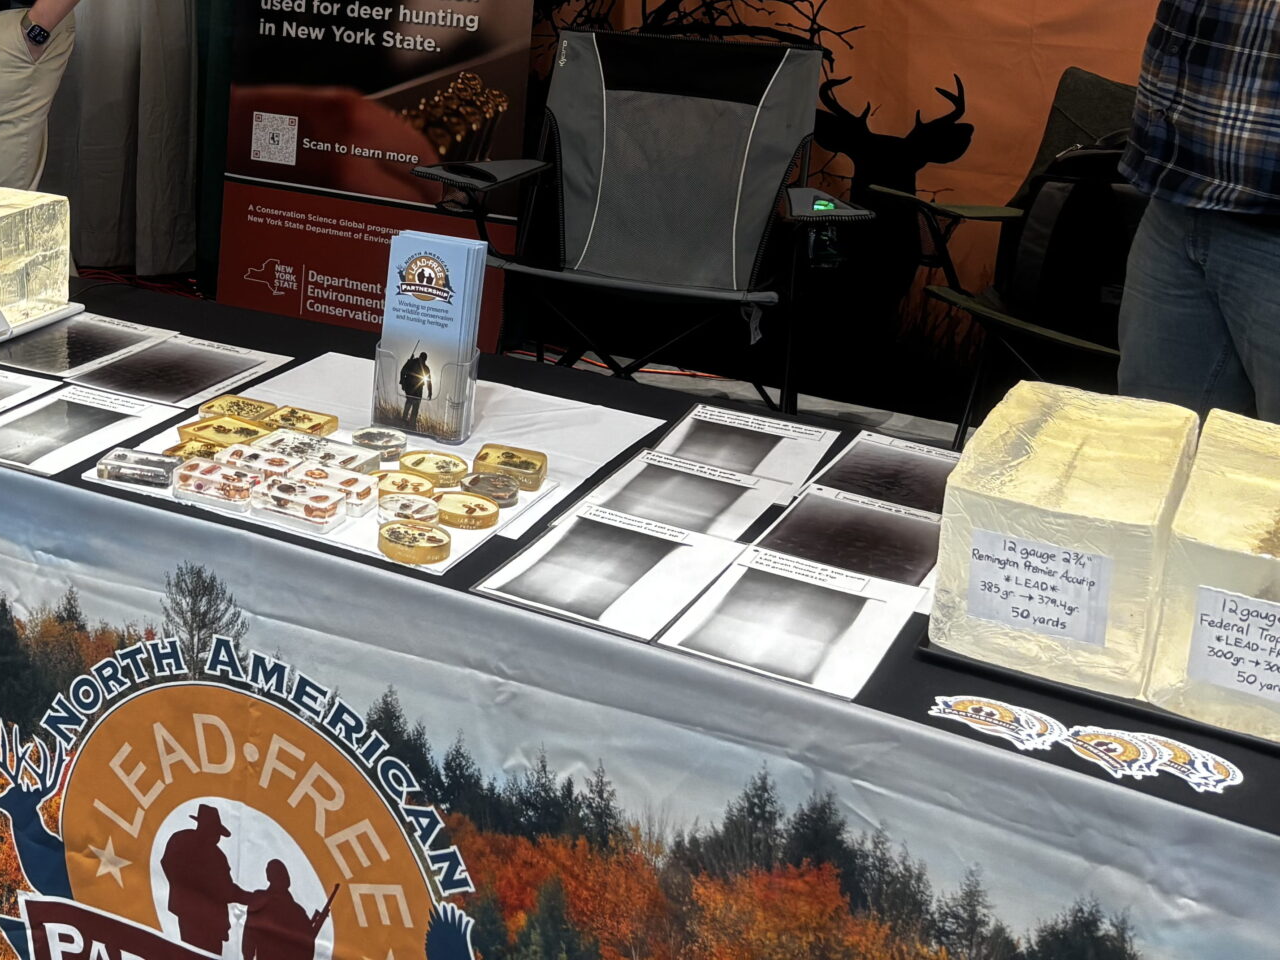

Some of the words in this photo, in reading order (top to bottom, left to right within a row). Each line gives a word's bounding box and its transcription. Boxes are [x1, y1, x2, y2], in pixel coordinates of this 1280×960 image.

[347, 1, 392, 20] deer
[399, 5, 479, 31] hunting
[259, 19, 275, 35] in
[283, 21, 325, 40] New
[332, 26, 375, 46] York
[382, 30, 440, 52] State.
[303, 138, 331, 151] Scan
[335, 142, 347, 154] to
[351, 145, 382, 160] learn
[386, 151, 418, 163] more
[247, 214, 263, 223] New
[266, 218, 283, 227] York
[284, 220, 304, 230] State
[306, 224, 352, 239] Department
[354, 230, 362, 239] of
[256, 205, 305, 220] Conservation
[307, 214, 337, 224] Science
[339, 219, 365, 229] Global
[275, 264, 293, 273] NEW
[405, 252, 421, 265] NORTH
[424, 251, 449, 273] AMERICAN
[274, 280, 297, 290] STATE
[275, 273, 296, 282] YORK
[308, 271, 381, 294] Department
[307, 285, 385, 310] Environment
[402, 285, 448, 297] PARTNERSHIP
[399, 300, 420, 310] Working
[427, 305, 448, 314] preserve
[402, 307, 420, 316] wildlife
[421, 310, 453, 322] conservation
[406, 315, 425, 325] hunting
[427, 319, 448, 328] heritage
[972, 548, 1019, 569] Remington
[1003, 540, 1017, 553] 12
[1020, 548, 1056, 564] gauge
[1011, 606, 1030, 619] 50
[1032, 616, 1067, 629] yards
[1222, 598, 1238, 615] 12
[1200, 613, 1250, 636] Federal
[1237, 671, 1257, 685] 50
[40, 637, 188, 749] NORTH
[204, 634, 475, 896] AMERICAN
